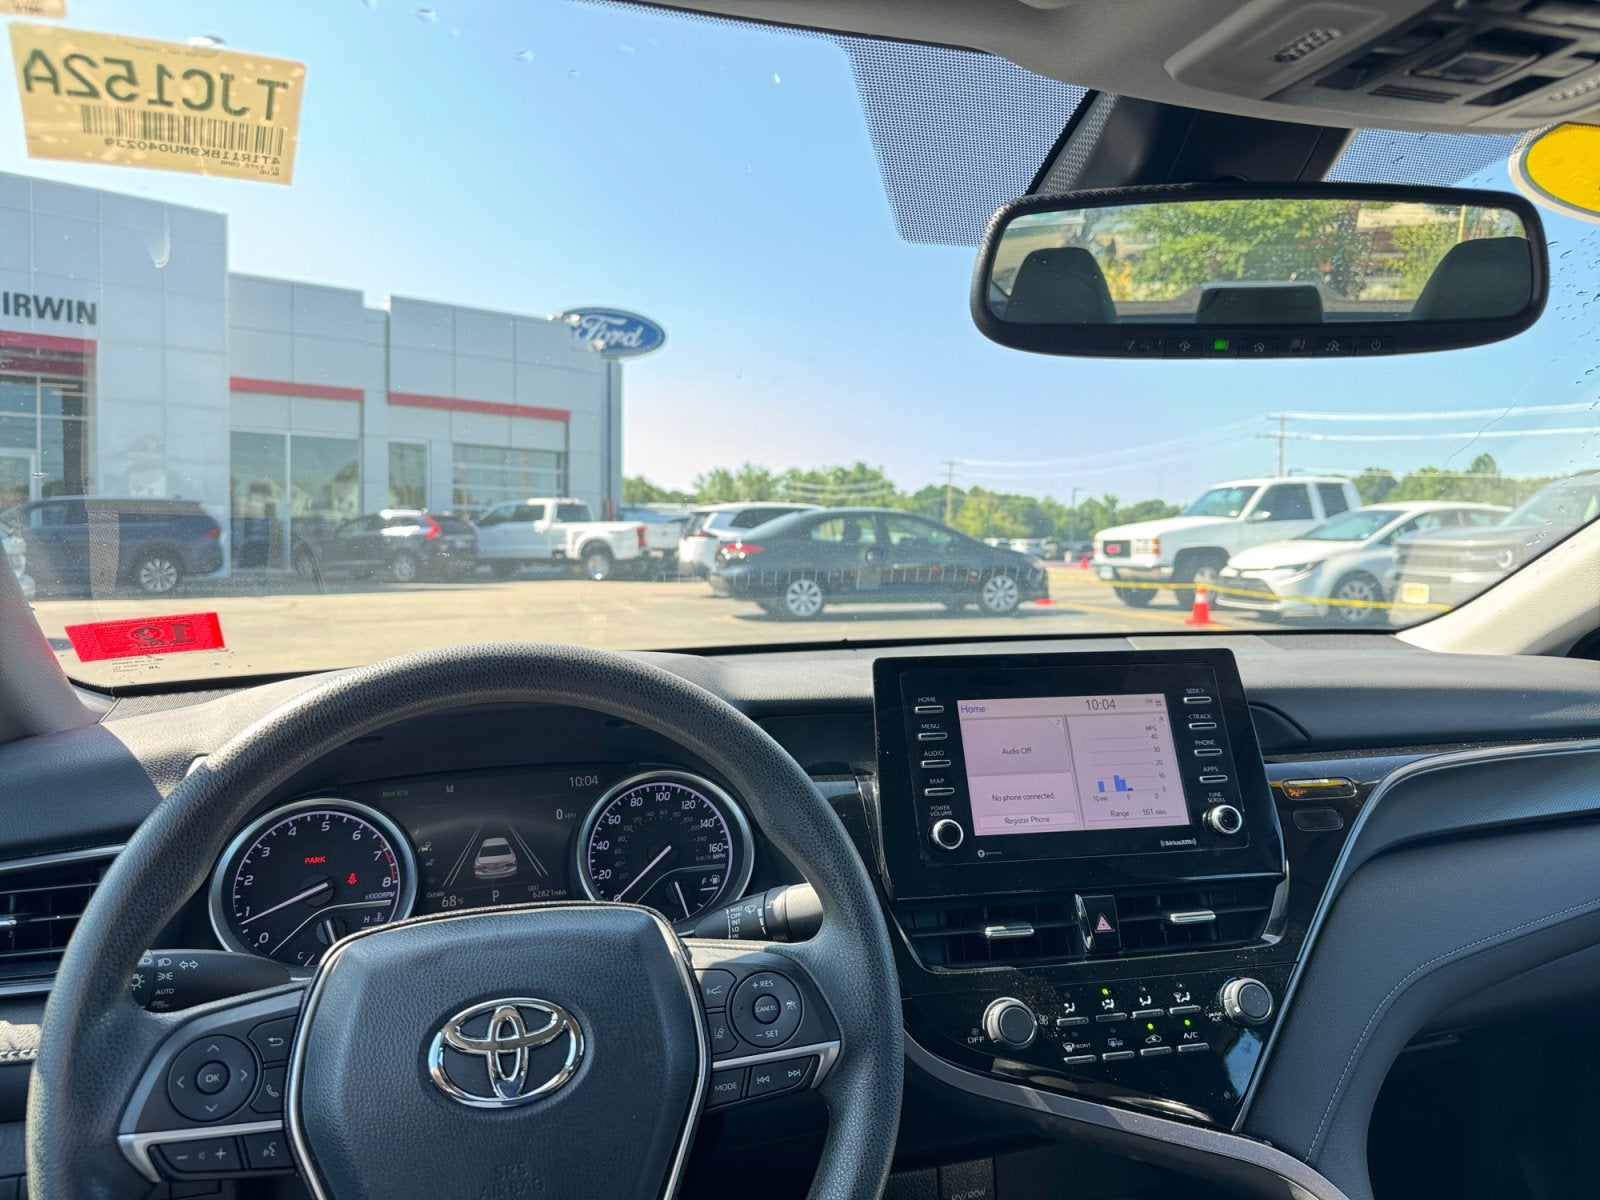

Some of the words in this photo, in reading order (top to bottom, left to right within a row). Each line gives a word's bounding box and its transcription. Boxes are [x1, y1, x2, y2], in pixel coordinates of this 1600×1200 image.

[2, 291, 97, 326] IRWIN
[576, 313, 645, 348] Ford
[960, 705, 986, 714] Home
[1086, 699, 1116, 711] 10:04
[1021, 746, 1032, 754] Off
[568, 775, 599, 788] 10:04
[655, 792, 670, 801] 100
[992, 794, 1002, 802] No
[1002, 794, 1022, 802] phone
[1023, 792, 1054, 800] connected
[630, 797, 643, 807] 80
[682, 800, 696, 810] 120
[556, 808, 563, 820] 0
[1110, 810, 1130, 818] Range
[608, 815, 621, 825] 60
[700, 818, 714, 828] 140
[1004, 816, 1030, 826] Register
[1030, 816, 1050, 824] Phone
[288, 826, 298, 837] 4
[321, 822, 330, 832] 5
[352, 830, 361, 840] 6
[596, 840, 610, 850] 40
[709, 843, 723, 852] 160
[261, 847, 270, 858] 3
[373, 851, 382, 861] 7
[304, 856, 326, 864] PARK
[599, 869, 612, 879] 20
[244, 875, 254, 886] 2
[382, 878, 391, 887] 8
[492, 890, 500, 902] P
[245, 906, 250, 916] 1
[364, 916, 370, 924] H
[259, 932, 270, 944] 0
[297, 952, 304, 960] C
[760, 980, 774, 988] RES
[756, 1004, 776, 1013] CANCEL
[765, 1030, 779, 1038] SET
[1183, 1031, 1199, 1040] A/C
[967, 1036, 985, 1044] OFF
[205, 1073, 220, 1083] OK
[714, 1082, 738, 1092] MODE
